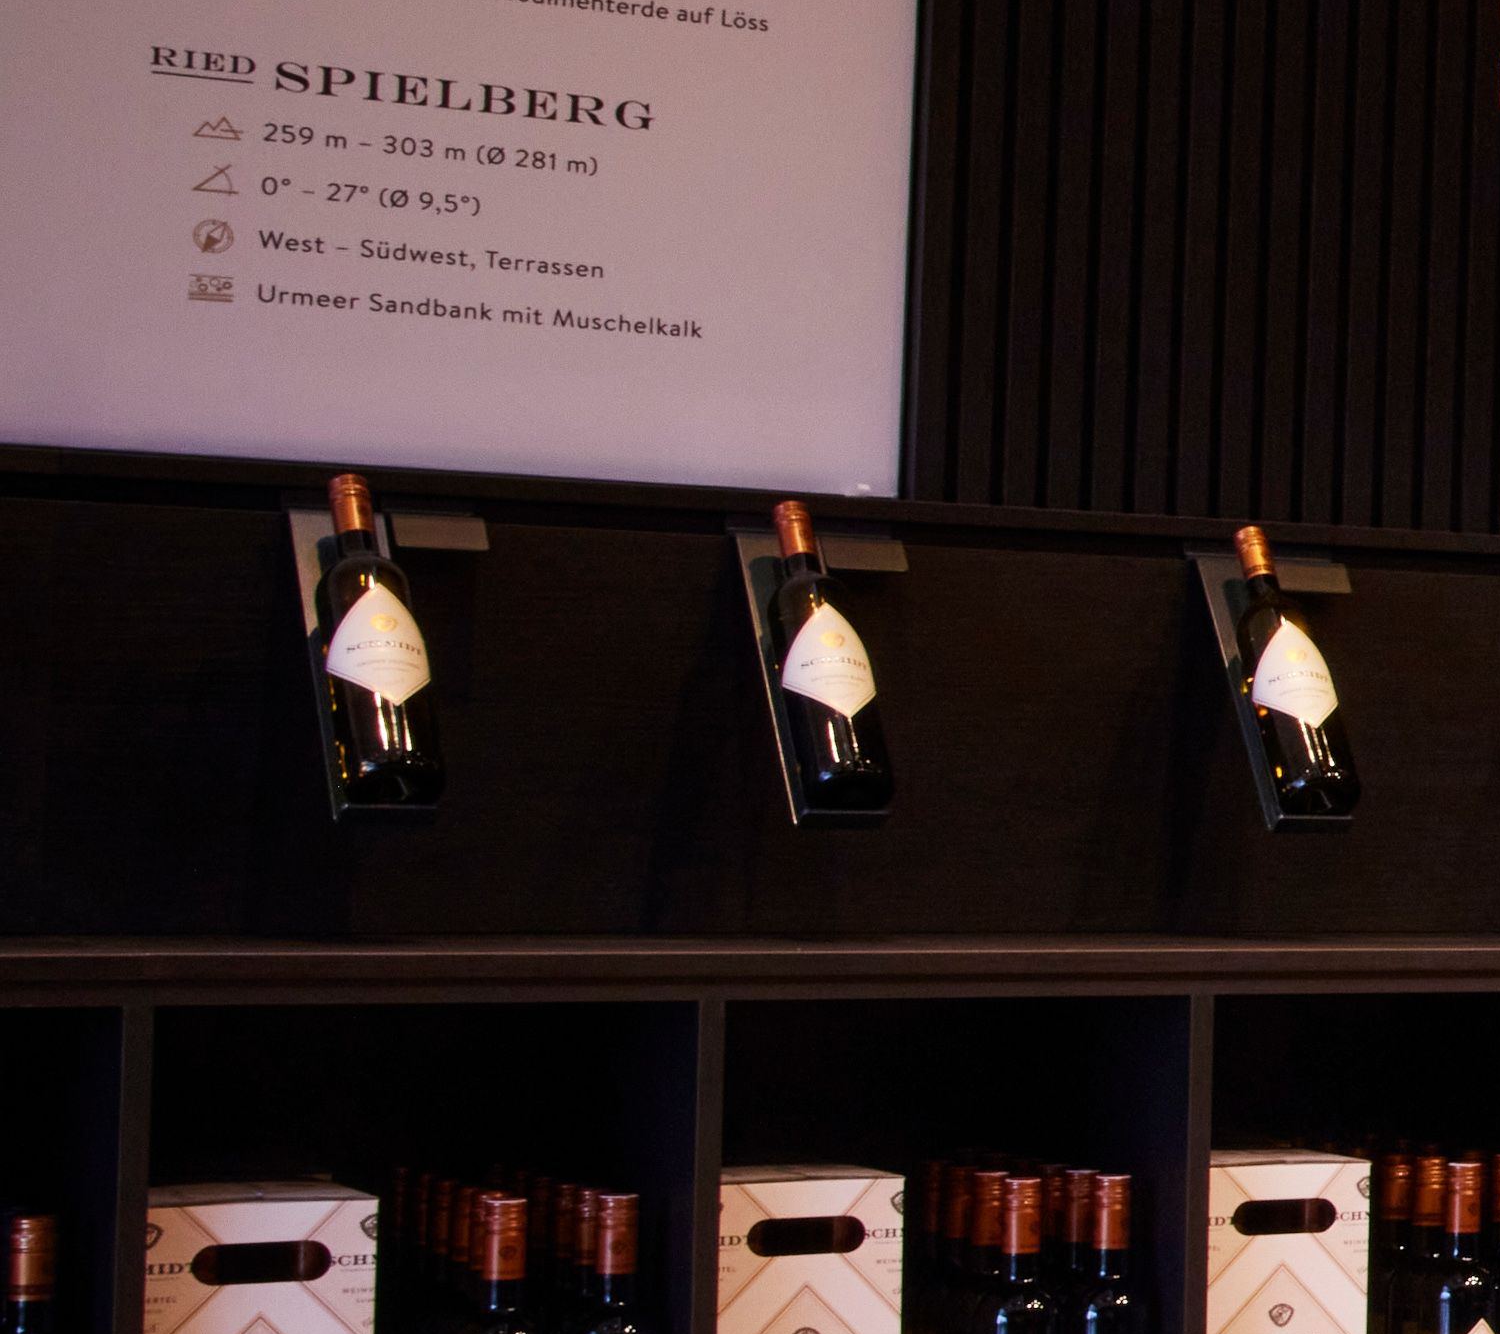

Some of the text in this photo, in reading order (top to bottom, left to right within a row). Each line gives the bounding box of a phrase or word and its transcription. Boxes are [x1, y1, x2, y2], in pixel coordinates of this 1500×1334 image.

[676, 6, 715, 25] auf
[720, 9, 769, 33] Löss
[150, 45, 654, 131] RIED SPIELBERG
[262, 122, 315, 146] 259
[324, 134, 348, 149] m
[383, 134, 434, 159] 303
[444, 146, 467, 161] m
[514, 148, 557, 171] 281
[566, 156, 599, 177] m)
[258, 229, 325, 255] West
[360, 238, 476, 270] Südwest,
[485, 249, 604, 279] Terrassen
[257, 283, 702, 339] Urmeer Sandbank mit Muschelkalk
